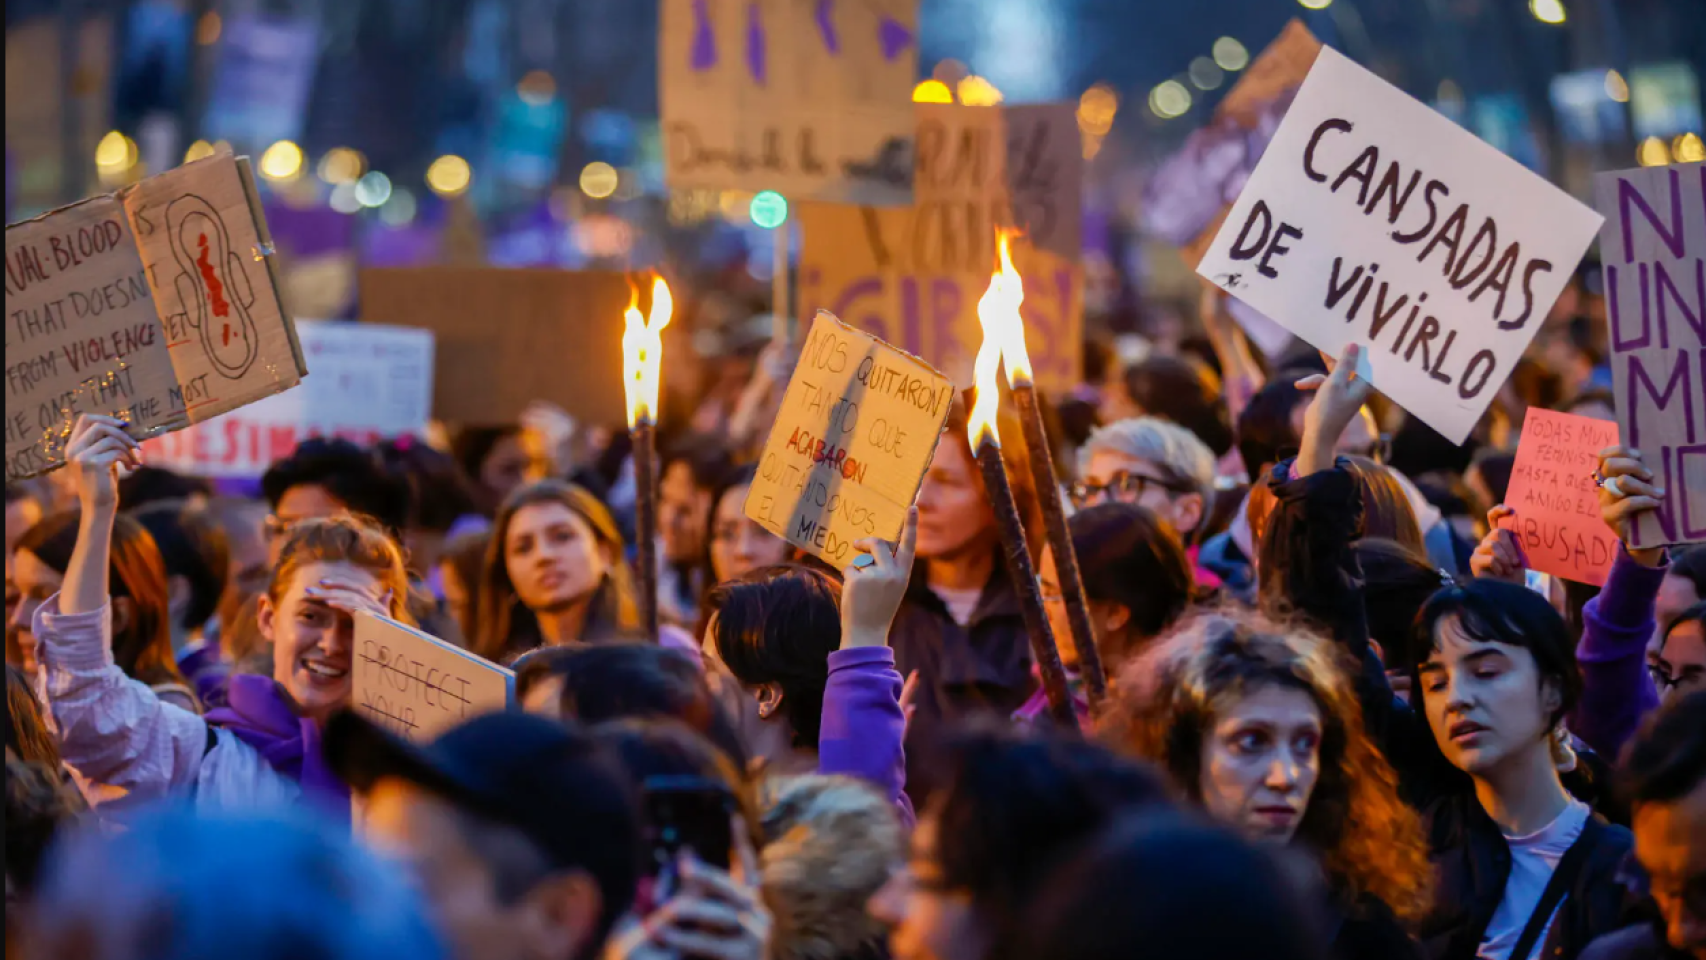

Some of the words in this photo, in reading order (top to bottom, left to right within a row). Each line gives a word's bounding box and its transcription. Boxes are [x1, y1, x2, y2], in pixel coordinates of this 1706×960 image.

[132, 204, 155, 236] IS
[1229, 199, 1303, 279] DE
[1303, 117, 1553, 331] CANSADAS
[11, 299, 67, 342] THAT
[6, 350, 58, 395] FROM
[62, 322, 157, 373] VIOLENCE
[802, 328, 848, 374] NOS
[857, 355, 946, 418] QUITARON
[128, 396, 160, 426] THE
[169, 372, 210, 407] MOST
[801, 380, 858, 434] TANTO
[868, 418, 907, 458] QUE
[786, 426, 868, 486] ACABARON
[1528, 416, 1572, 443] TODAS
[1577, 425, 1612, 448] MUY
[1516, 464, 1559, 486] HASTA
[1565, 475, 1590, 494] QUE
[1525, 487, 1571, 513] AMIGO
[1575, 498, 1597, 519] EL
[758, 495, 781, 528] EL
[796, 513, 849, 561] MIEDO
[360, 639, 472, 719] PROTECT
